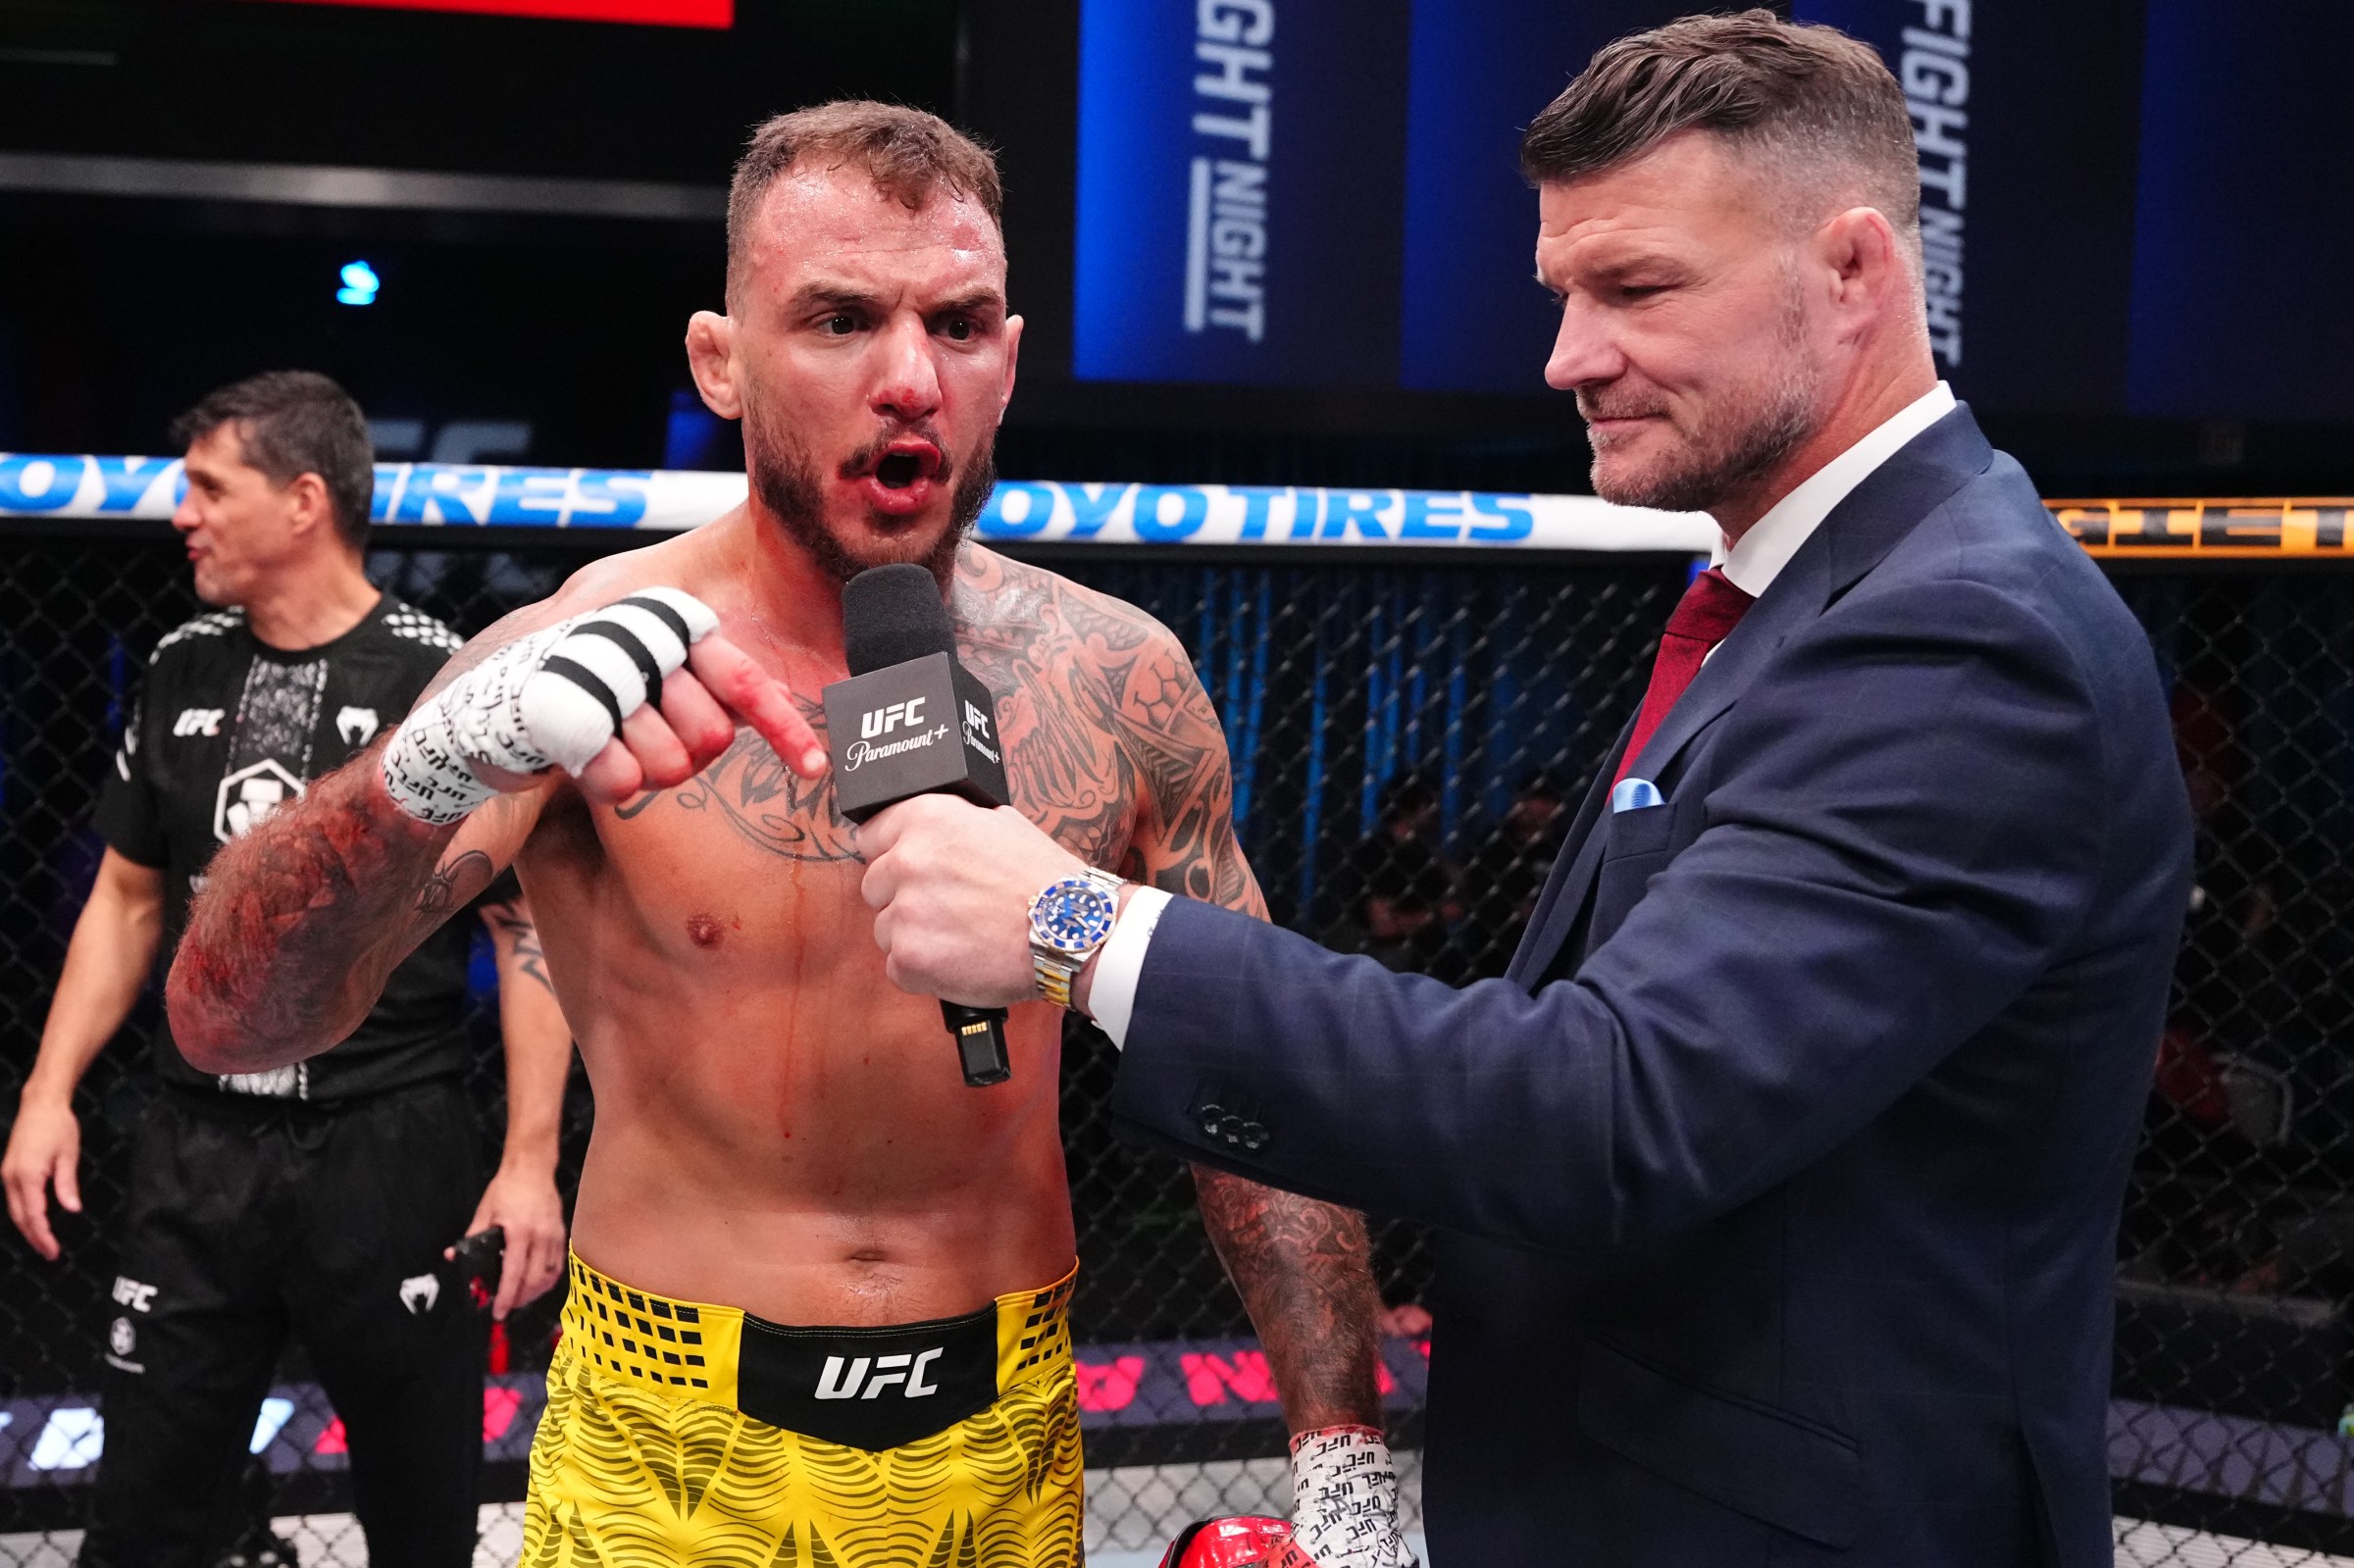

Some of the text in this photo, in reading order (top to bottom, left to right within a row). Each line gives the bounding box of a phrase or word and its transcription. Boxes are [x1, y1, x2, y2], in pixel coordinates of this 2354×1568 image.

[1208, 160, 1268, 342] NIGHT
[1919, 204, 1966, 368] NIGHT
[0, 453, 189, 511] OY
[1222, 485, 1534, 541] TIRES
[173, 708, 226, 736] UFC
[860, 696, 926, 739] UFC
[964, 699, 990, 739] UFC
[844, 724, 949, 772] Paramount+
[814, 1346, 945, 1400] UFC
[1316, 1435, 1352, 1458] UFC
[1345, 1451, 1375, 1467] UFC
[1318, 1482, 1354, 1499] UFC
[1345, 1518, 1377, 1541] UFC
